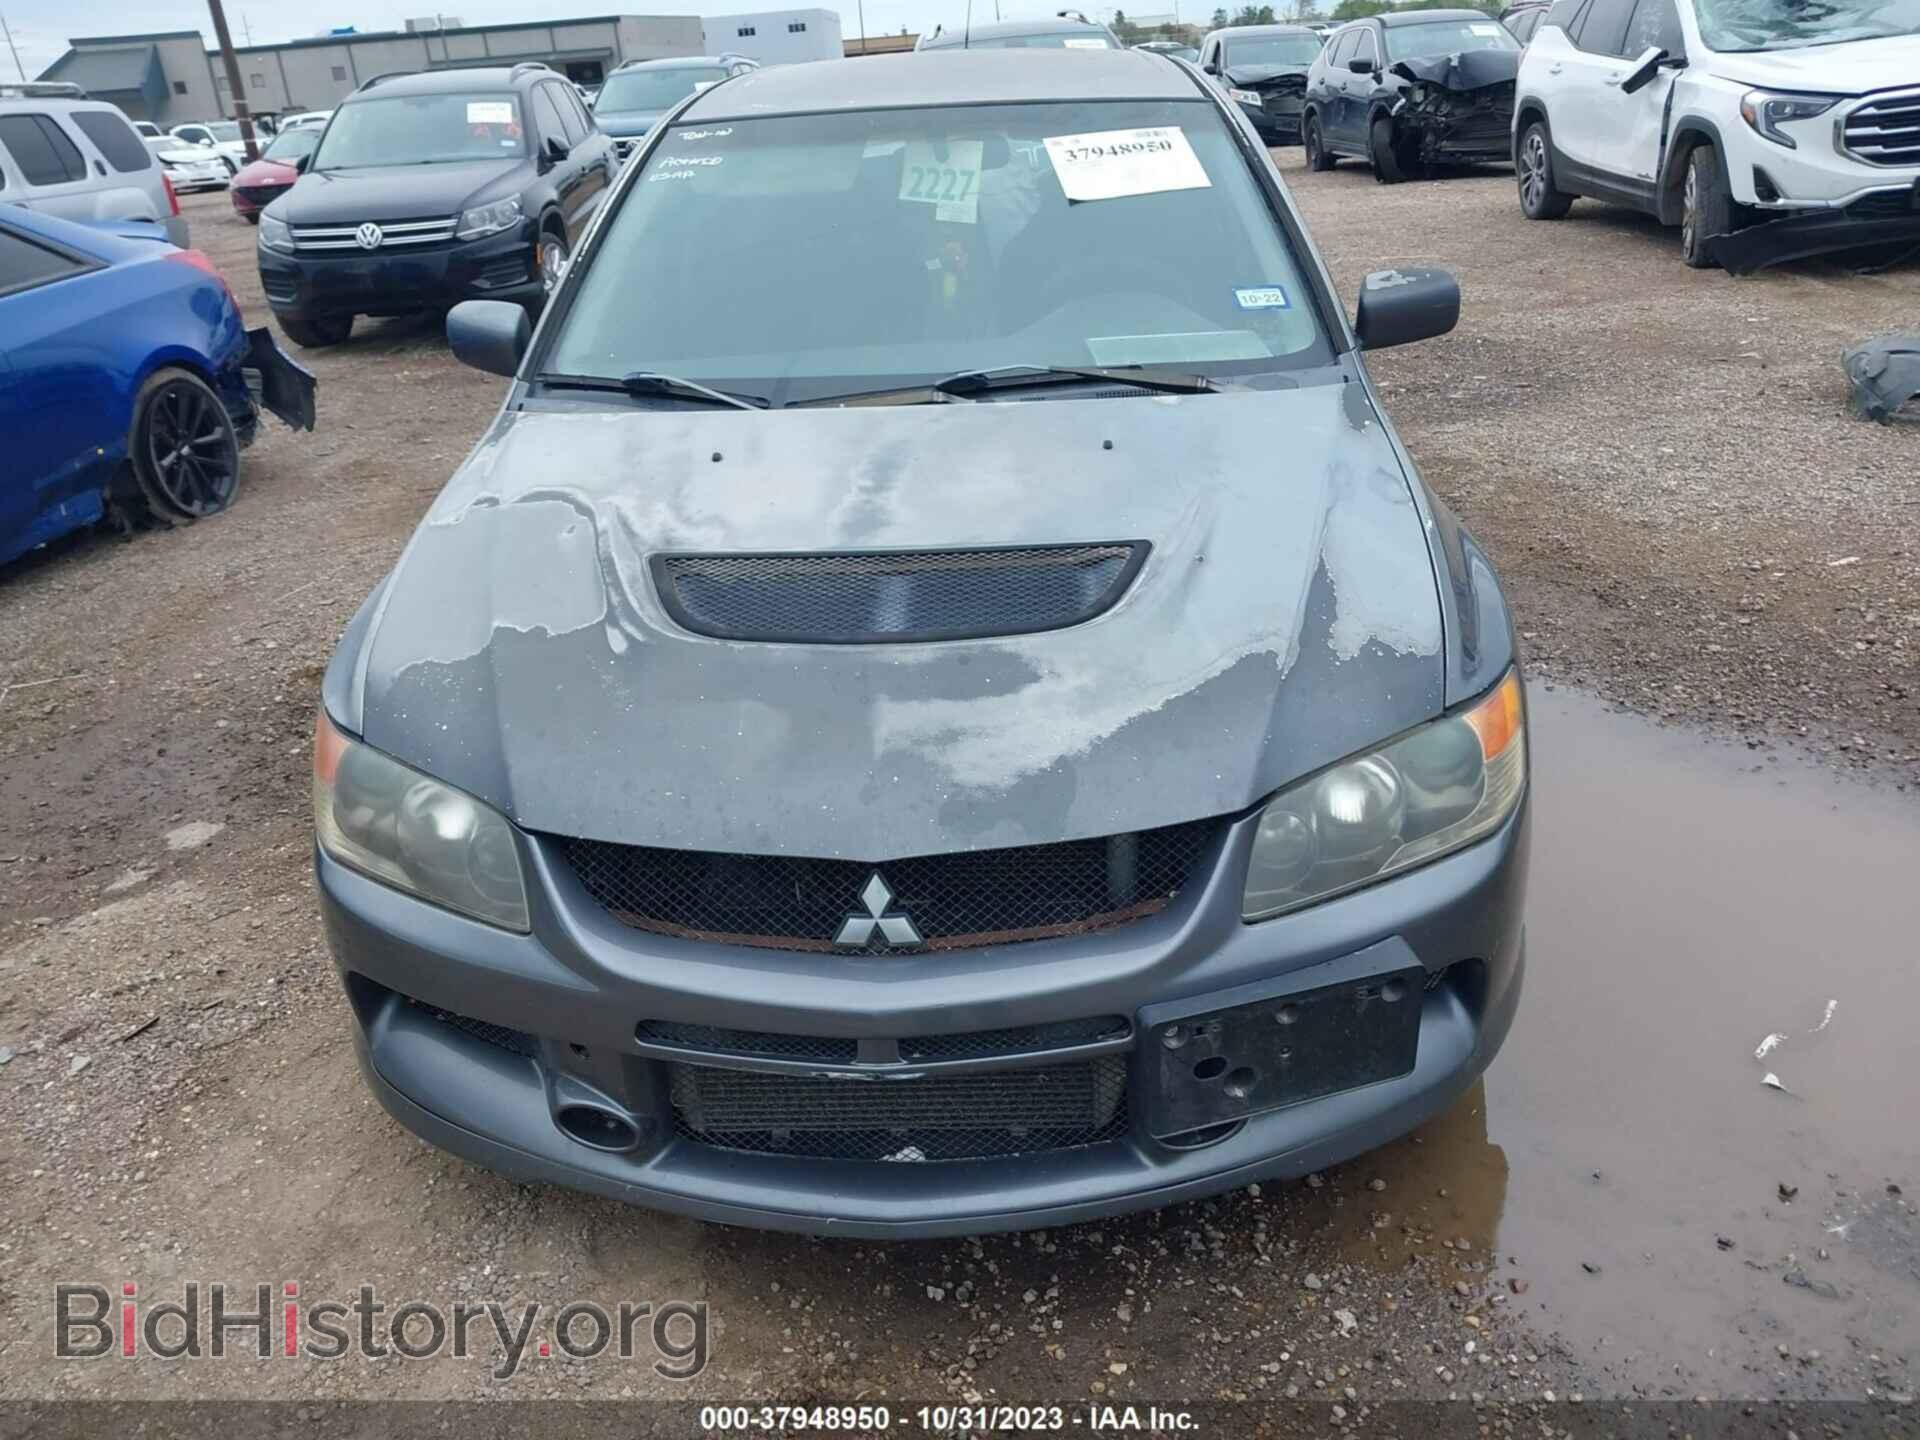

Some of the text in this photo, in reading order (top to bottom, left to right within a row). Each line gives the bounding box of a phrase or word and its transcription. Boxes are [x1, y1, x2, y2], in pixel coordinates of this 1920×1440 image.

[1065, 140, 1172, 162] 37948950
[911, 167, 976, 201] 2227
[1242, 293, 1281, 304] 10-22
